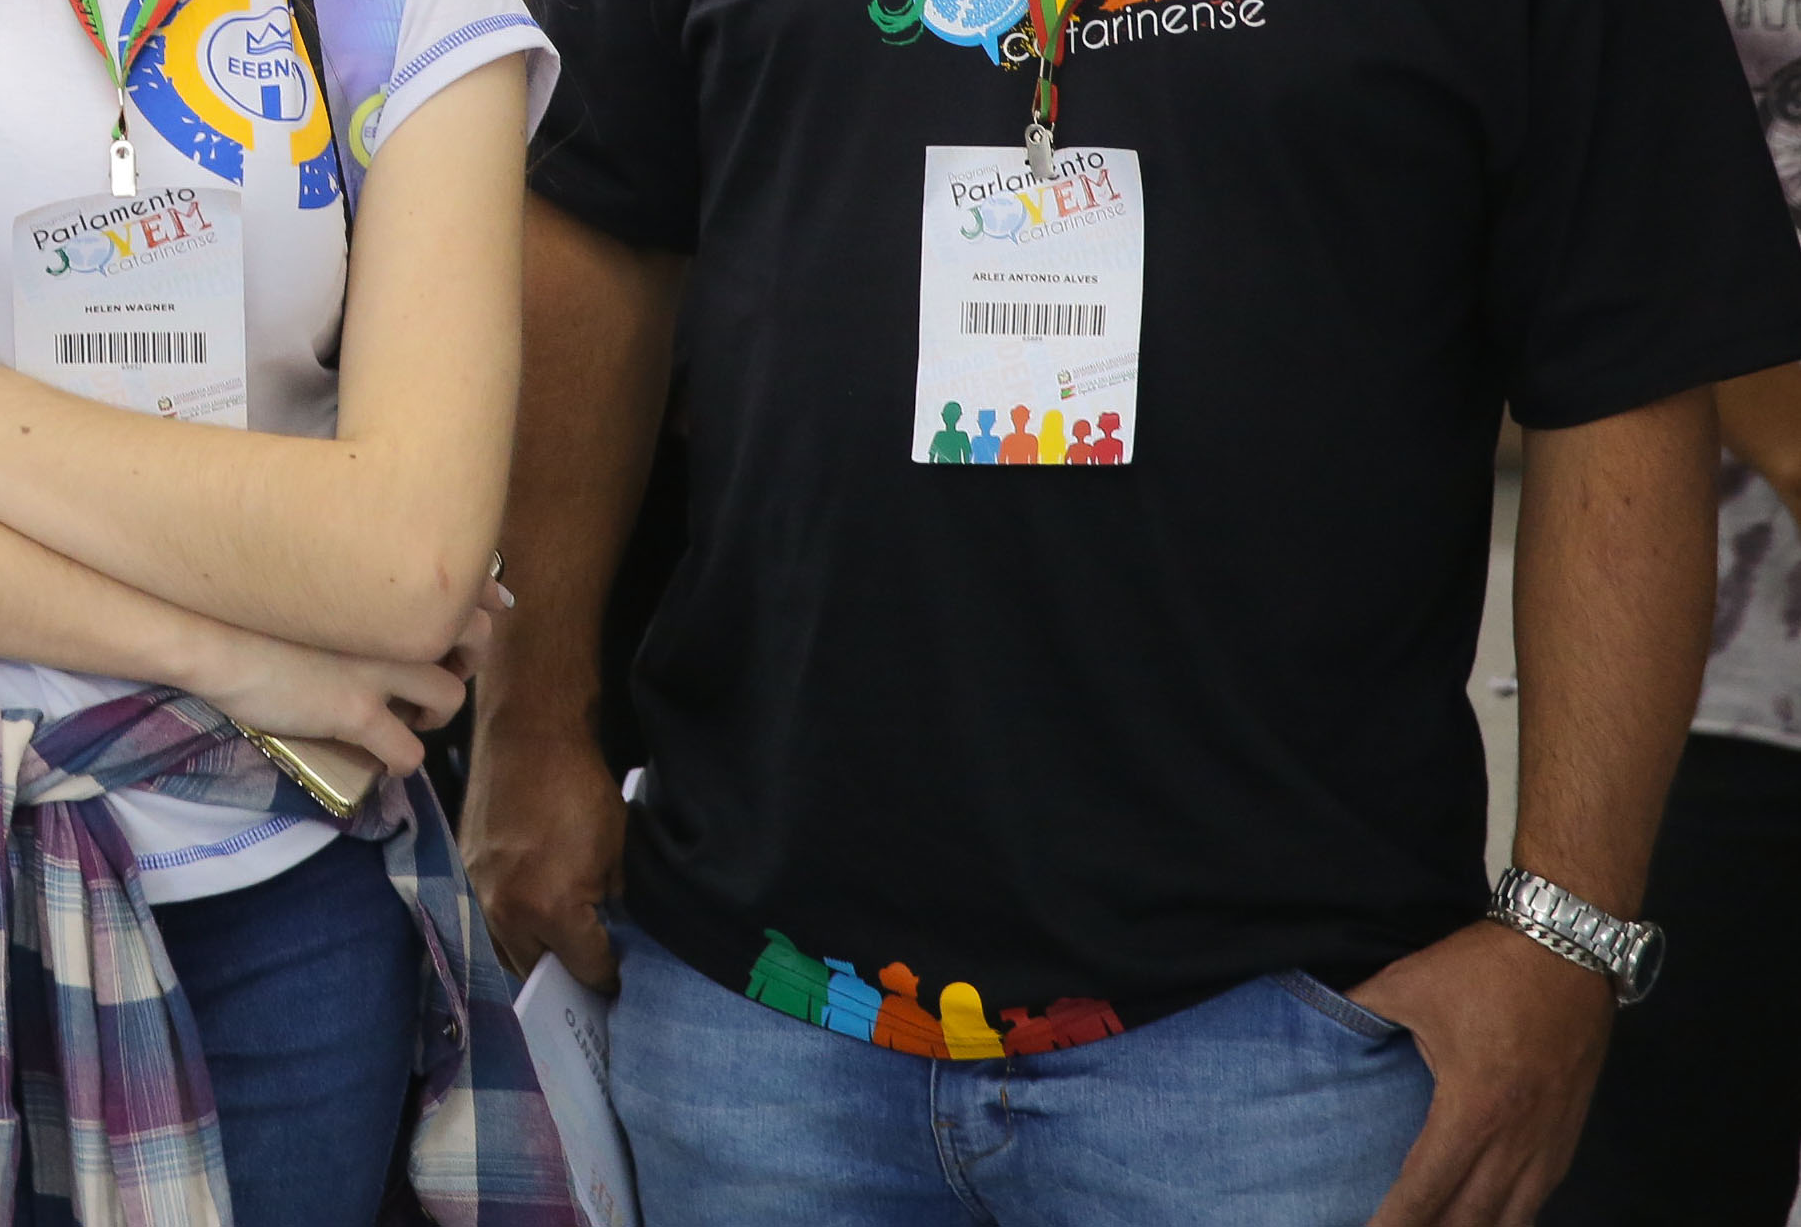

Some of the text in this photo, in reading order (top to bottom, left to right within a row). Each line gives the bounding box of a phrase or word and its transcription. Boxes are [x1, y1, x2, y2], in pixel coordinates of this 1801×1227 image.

[951, 151, 1105, 207] Parlanto
[33, 187, 196, 250] Parlamento
[1018, 201, 1126, 244] catarinense
[107, 230, 218, 275] catarinense
[973, 271, 1099, 284] ARLEI ANTONIO ALVES
[85, 303, 176, 314] HELEN WAGNER
